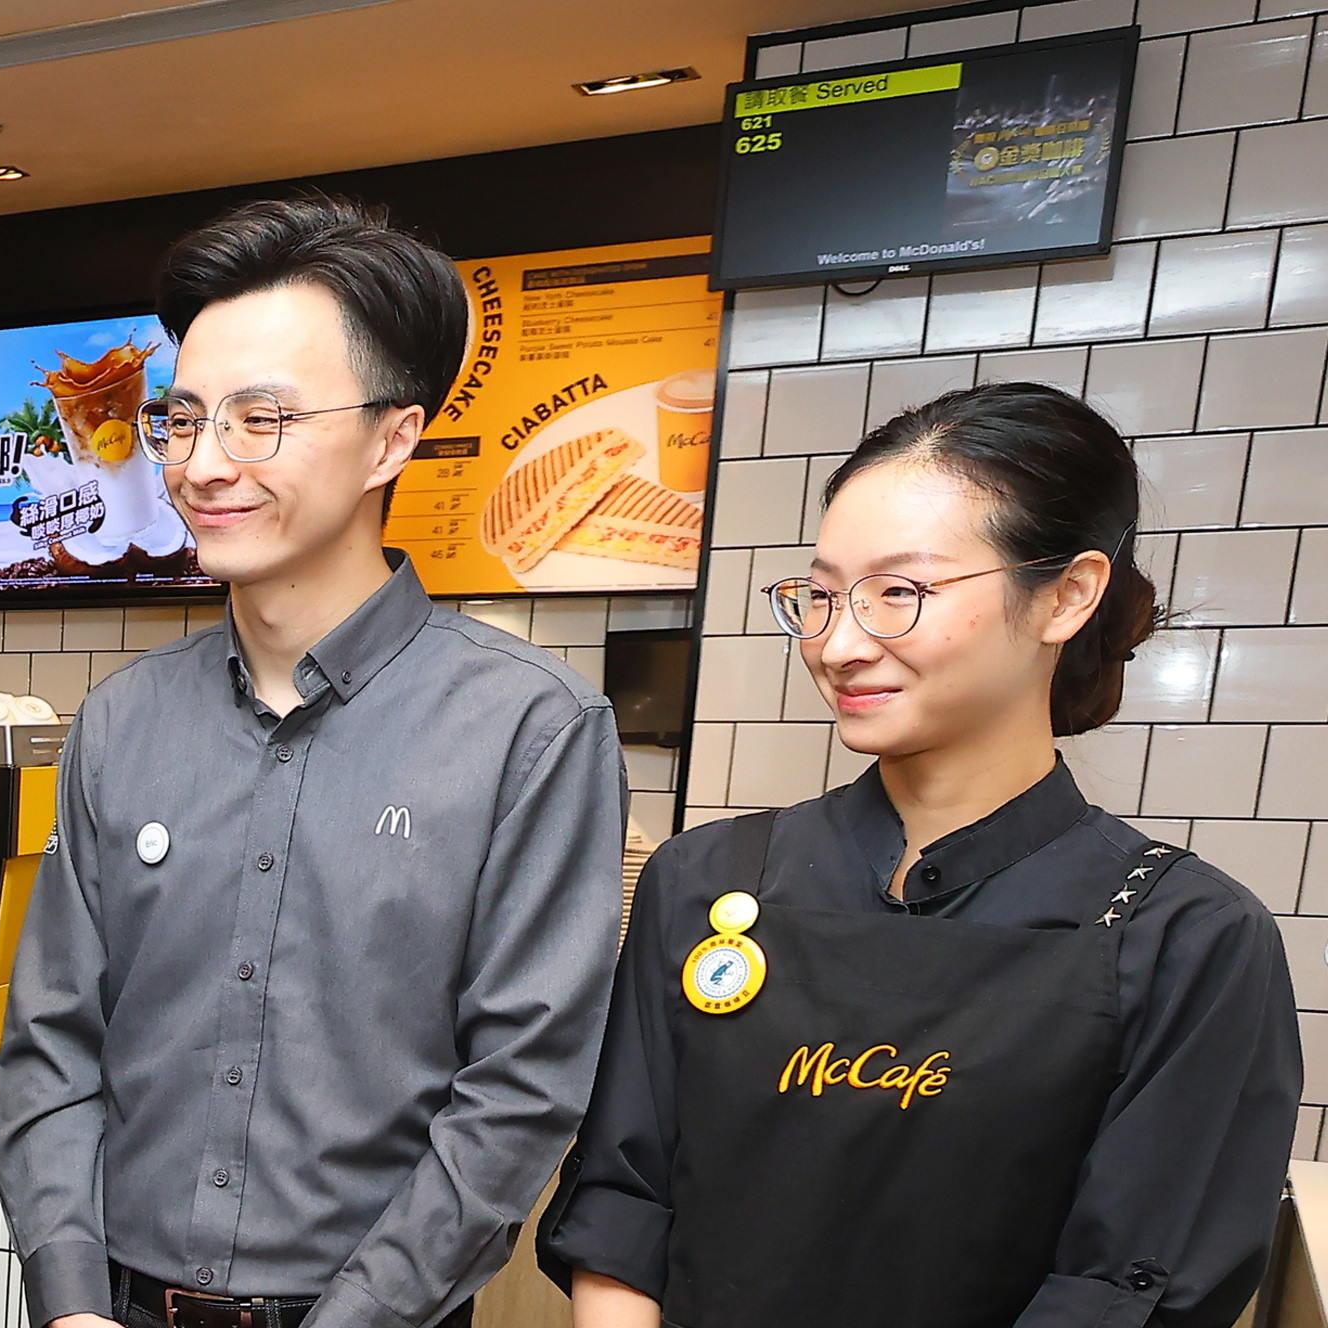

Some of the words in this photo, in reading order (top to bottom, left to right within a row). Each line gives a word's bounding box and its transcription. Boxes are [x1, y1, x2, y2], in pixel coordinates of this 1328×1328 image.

[744, 84, 809, 110] 請取餐
[816, 75, 889, 100] Served
[735, 132, 783, 155] 625
[741, 115, 773, 131] 621
[817, 250, 879, 265] Welcome
[881, 248, 896, 260] to
[898, 238, 985, 258] McDonald's!
[442, 265, 504, 422] CHEESECAKE
[500, 373, 608, 451] CIABATTA
[20, 480, 99, 527] 絲滑口感
[777, 1041, 953, 1111] McCafé
